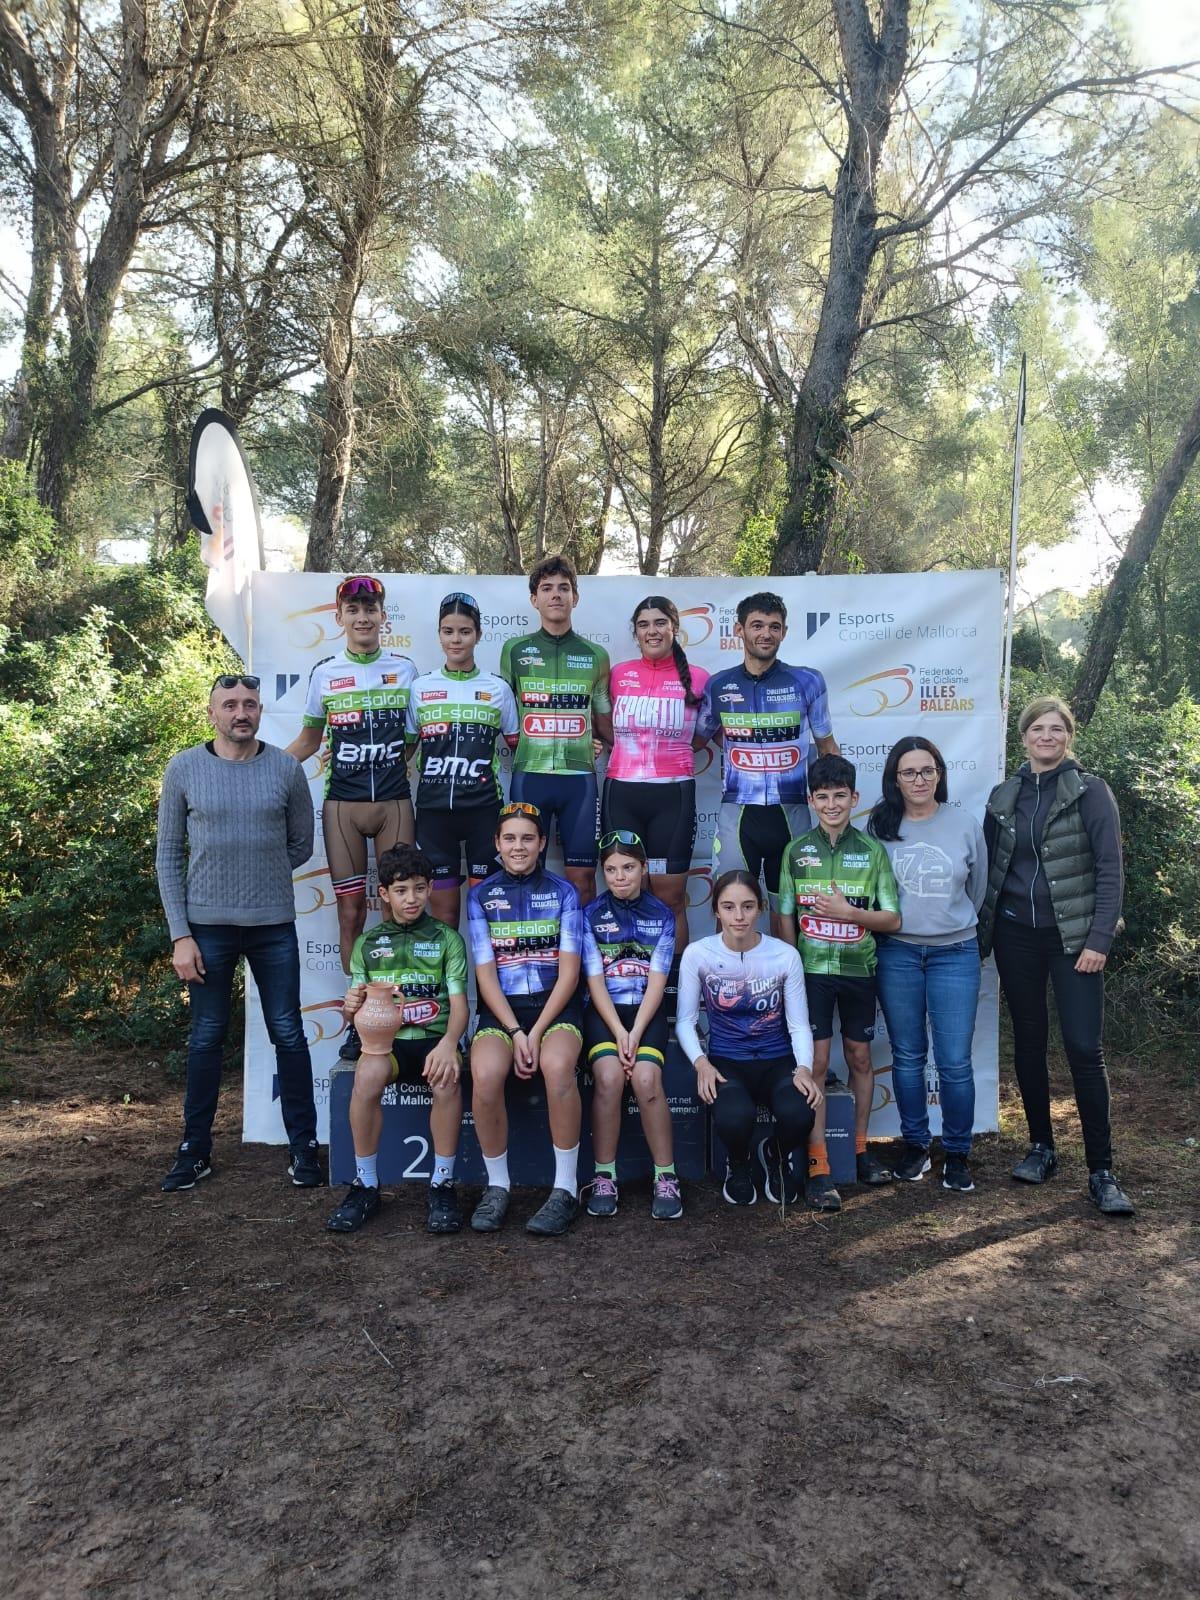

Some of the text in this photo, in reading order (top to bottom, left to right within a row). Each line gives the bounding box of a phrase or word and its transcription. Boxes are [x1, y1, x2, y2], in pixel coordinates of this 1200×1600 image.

[839, 612, 895, 628] Esports
[839, 624, 977, 641] Consell de Mallorca
[919, 667, 963, 676] Federació
[933, 675, 969, 685] Ciclisme
[524, 693, 549, 702] PRO
[920, 685, 956, 698] ILLES
[920, 699, 975, 711] BALEARS
[529, 718, 581, 733] ABUS
[723, 715, 794, 726] rad-salon
[422, 723, 495, 737] PRO RENT
[655, 729, 681, 738] PUIG
[725, 727, 796, 736] PRO RENT
[337, 740, 404, 762] BMC
[738, 752, 793, 766] ABUS
[423, 756, 491, 777] BMC
[806, 919, 859, 938] ABUS
[519, 935, 559, 946] RENT
[306, 940, 341, 957] Espo
[306, 957, 342, 971] Cons
[403, 984, 438, 992] RENT
[402, 1135, 431, 1178] 2
